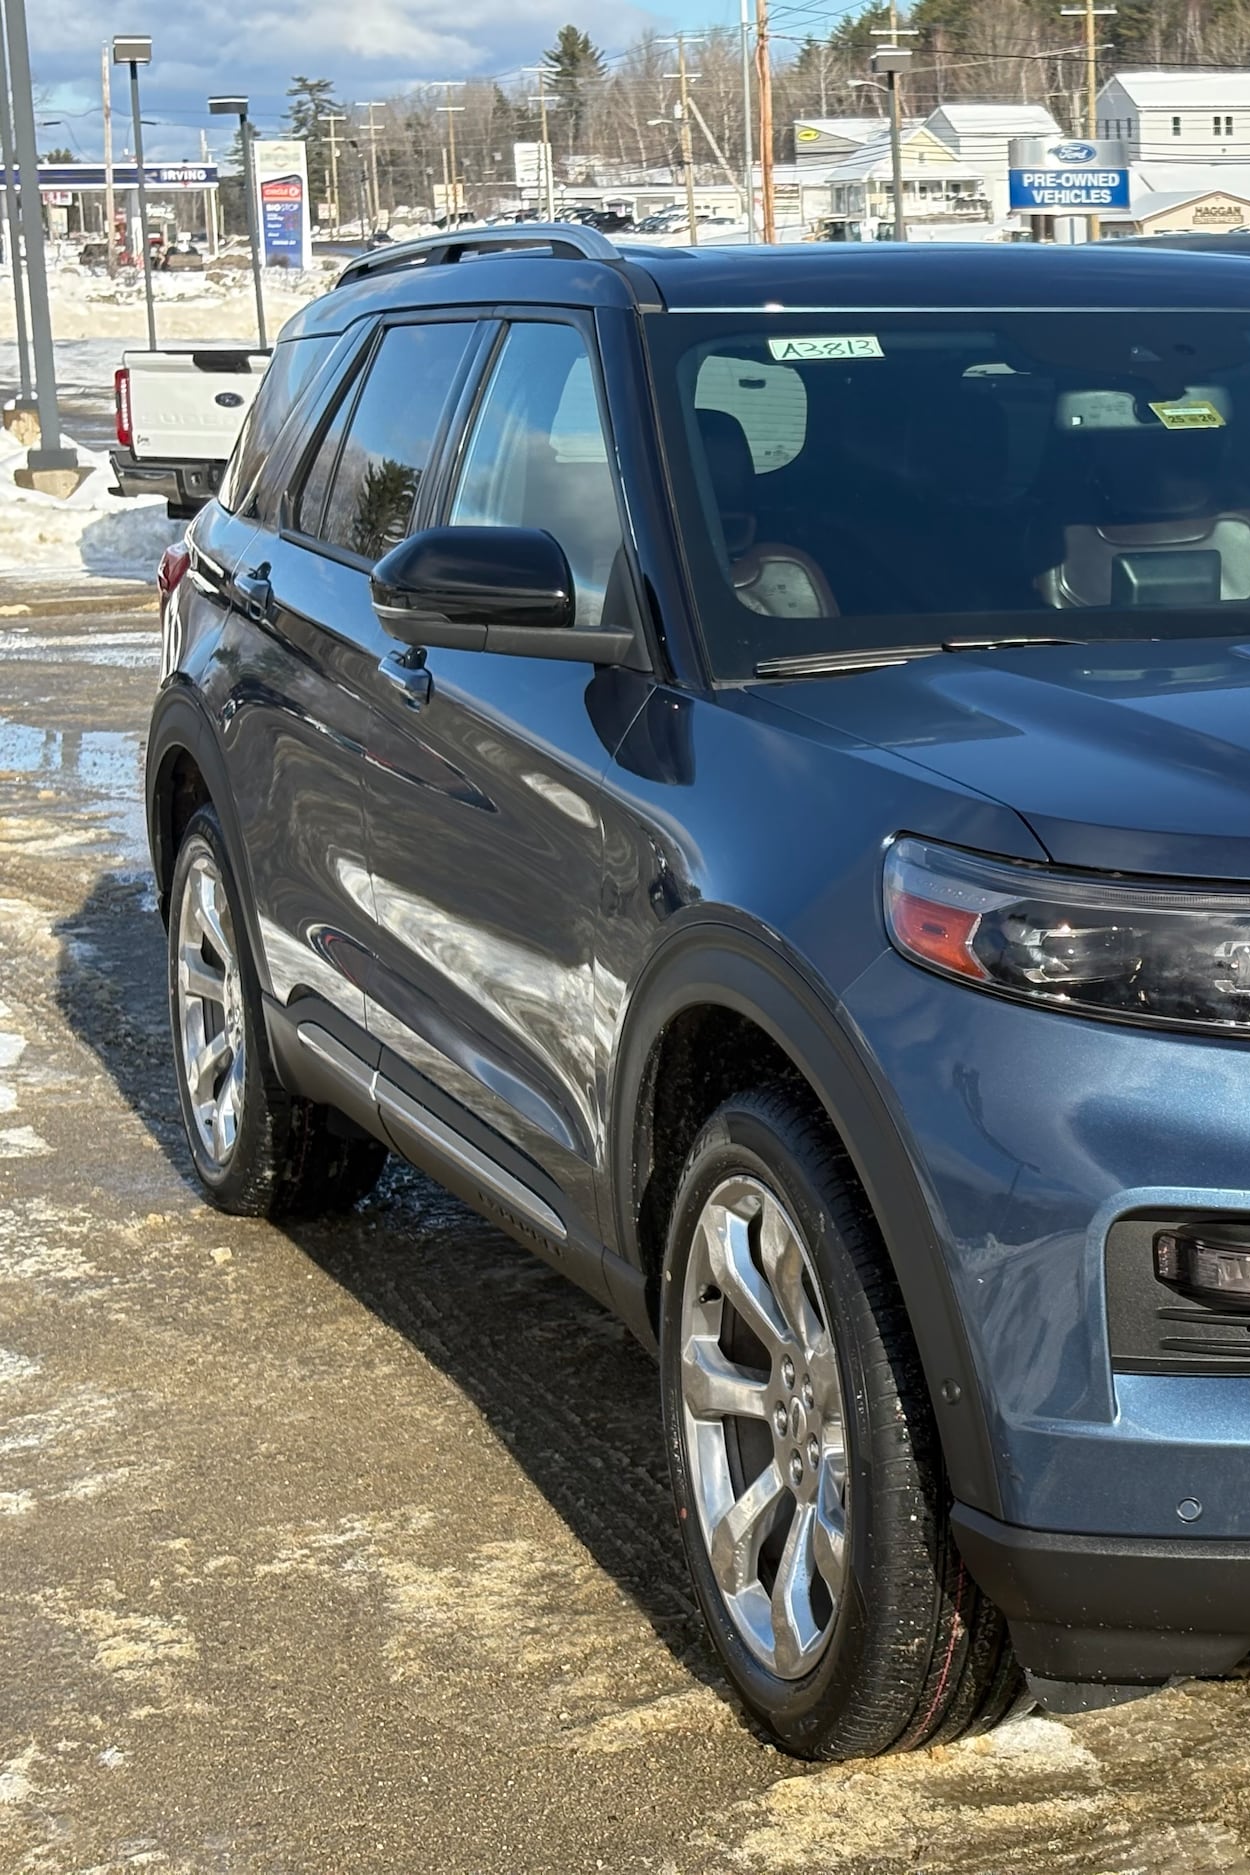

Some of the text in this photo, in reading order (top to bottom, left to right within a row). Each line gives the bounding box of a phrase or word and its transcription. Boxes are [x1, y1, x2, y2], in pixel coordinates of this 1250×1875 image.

[161, 169, 207, 181] IRVING
[1022, 172, 1120, 188] PRE-OWNED
[1032, 189, 1112, 204] VEHICLES
[781, 339, 875, 358] A3813
[1168, 415, 1185, 424] 25
